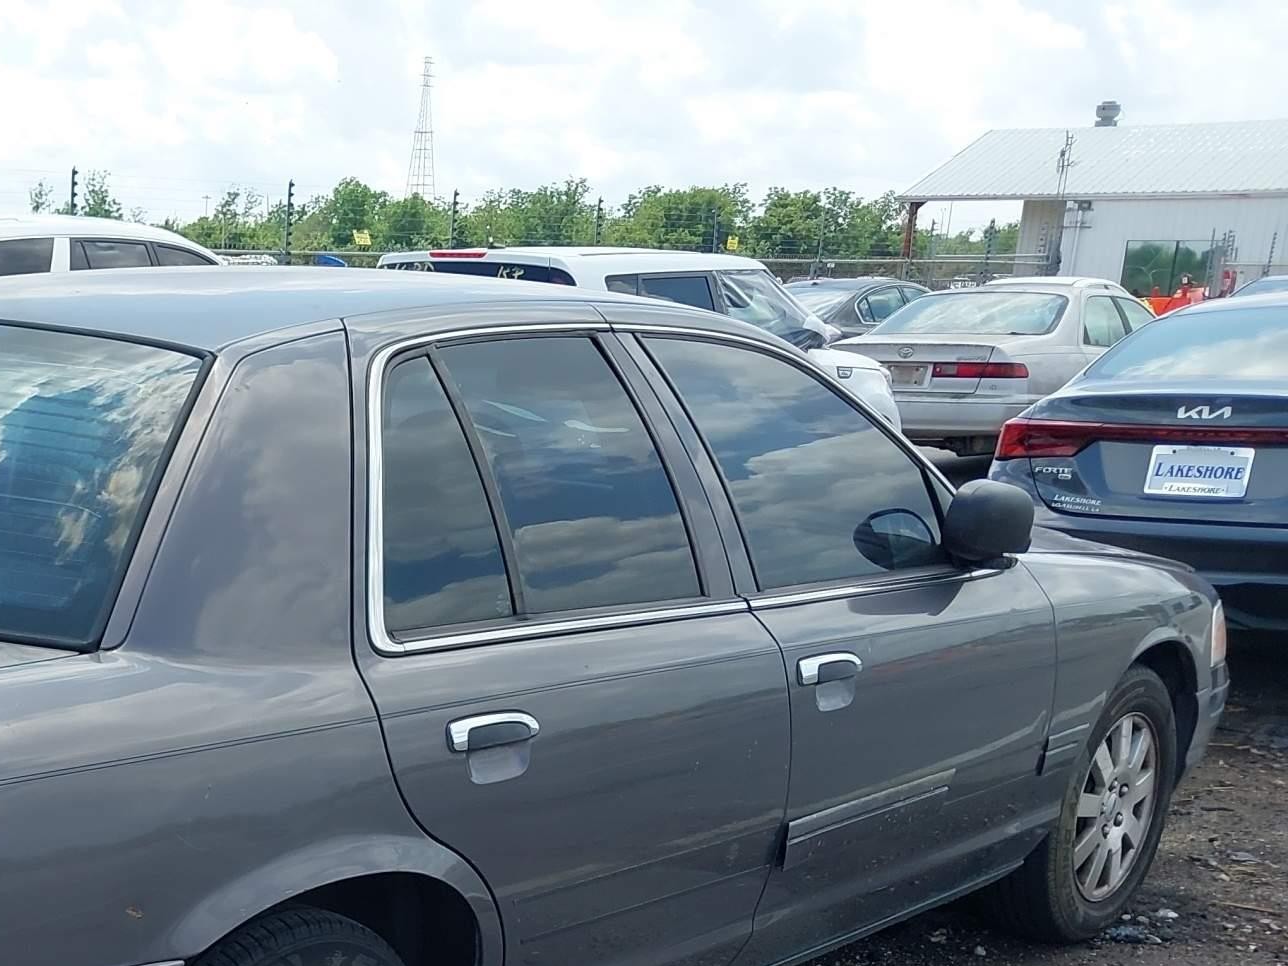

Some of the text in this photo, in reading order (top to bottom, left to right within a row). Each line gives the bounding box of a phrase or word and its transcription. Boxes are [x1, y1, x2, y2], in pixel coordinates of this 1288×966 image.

[1176, 405, 1232, 419] KIA
[1034, 466, 1072, 474] FORTE
[1154, 462, 1245, 480] LAKESHORE
[1168, 485, 1222, 494] LAKESHORE
[1053, 494, 1101, 505] LAKESHORE
